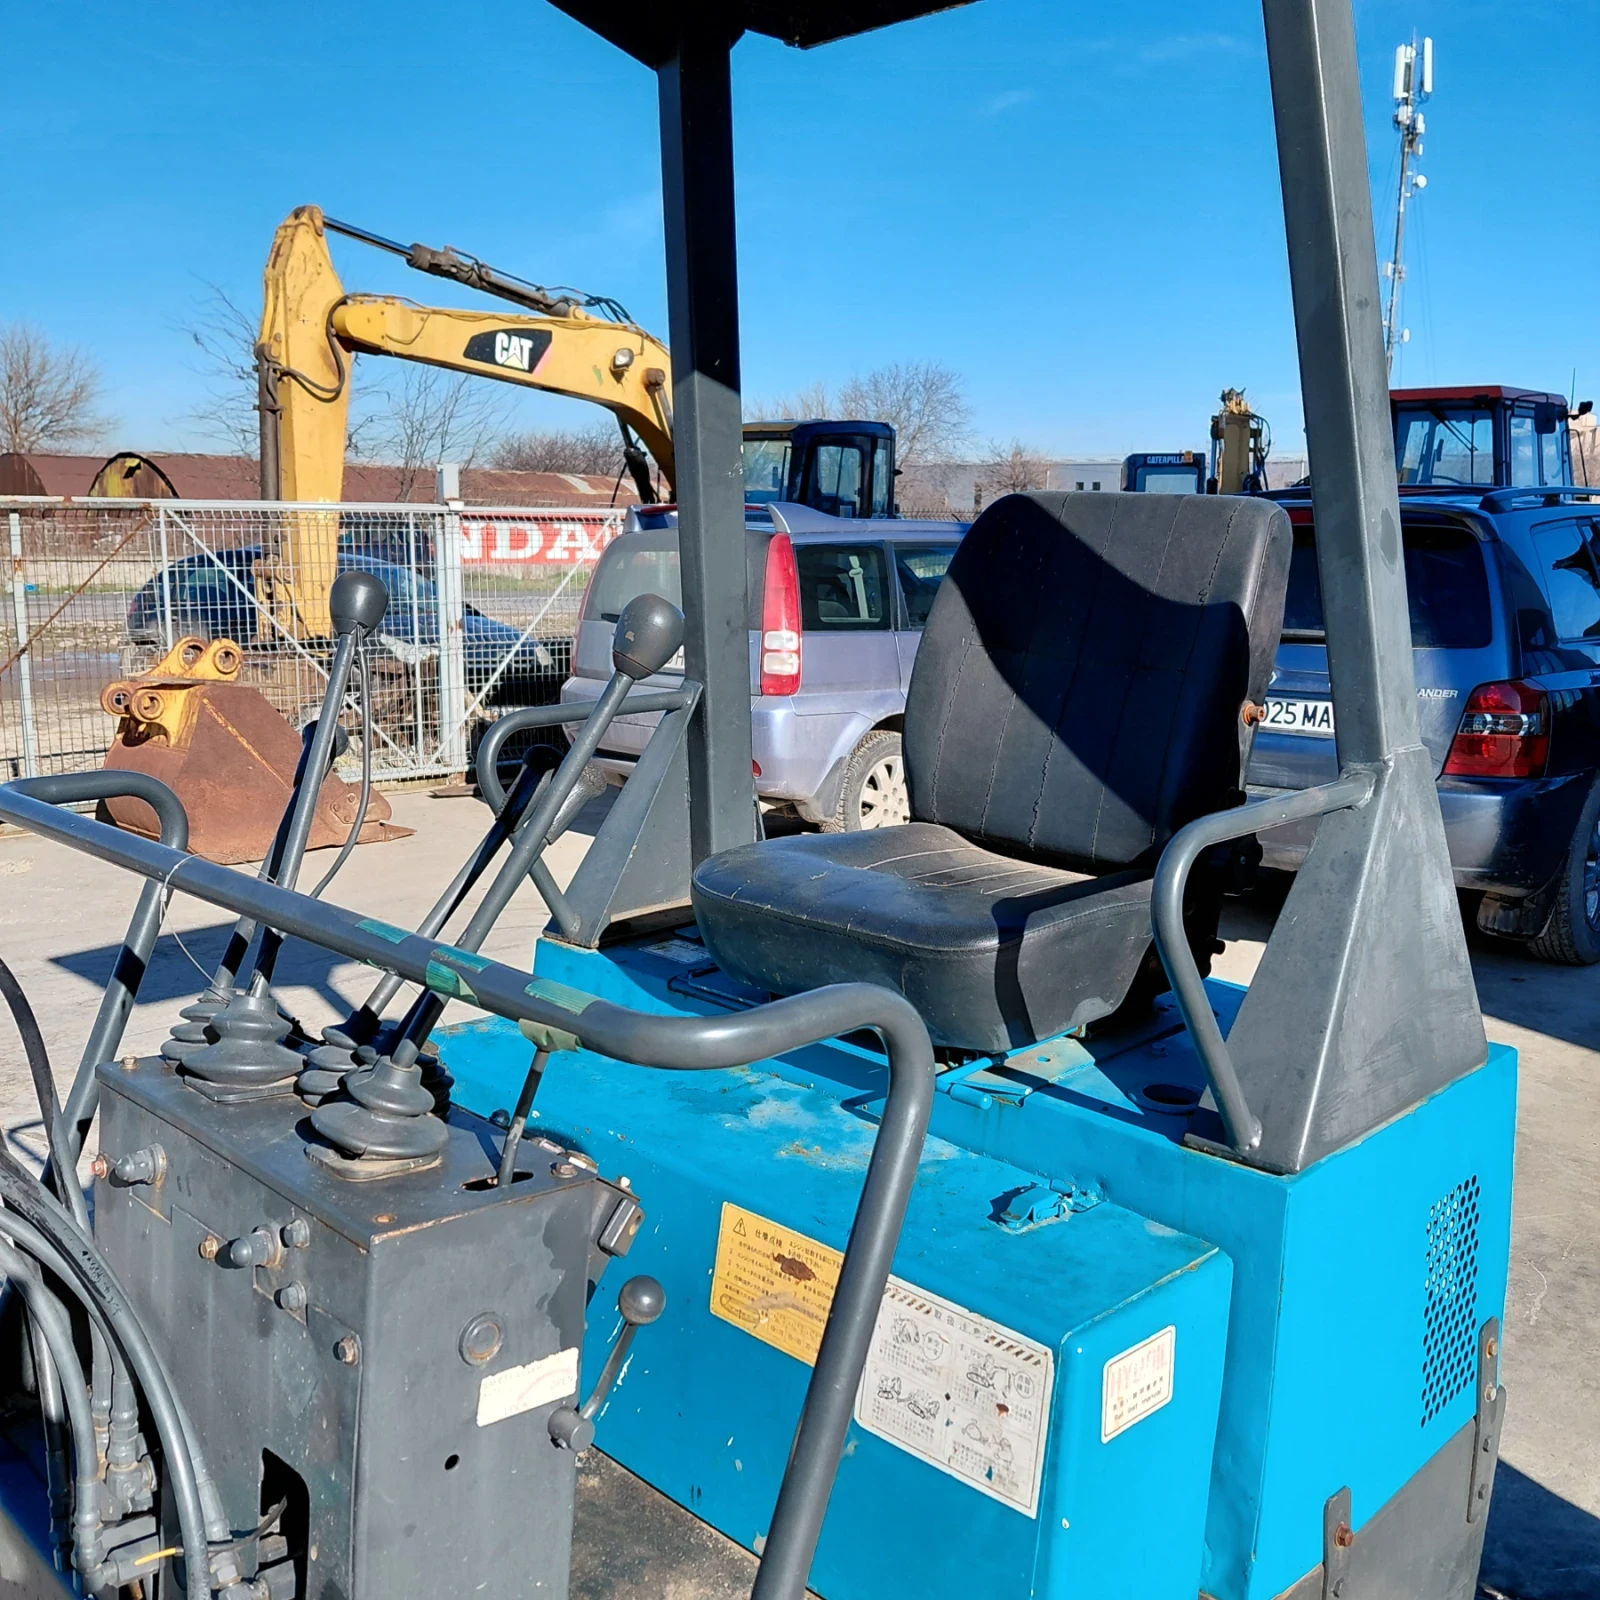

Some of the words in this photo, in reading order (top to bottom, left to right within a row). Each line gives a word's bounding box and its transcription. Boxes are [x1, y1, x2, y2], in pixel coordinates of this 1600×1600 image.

[494, 331, 533, 370] CAT
[1146, 455, 1185, 464] CATERPILLA
[1302, 704, 1331, 729] MA
